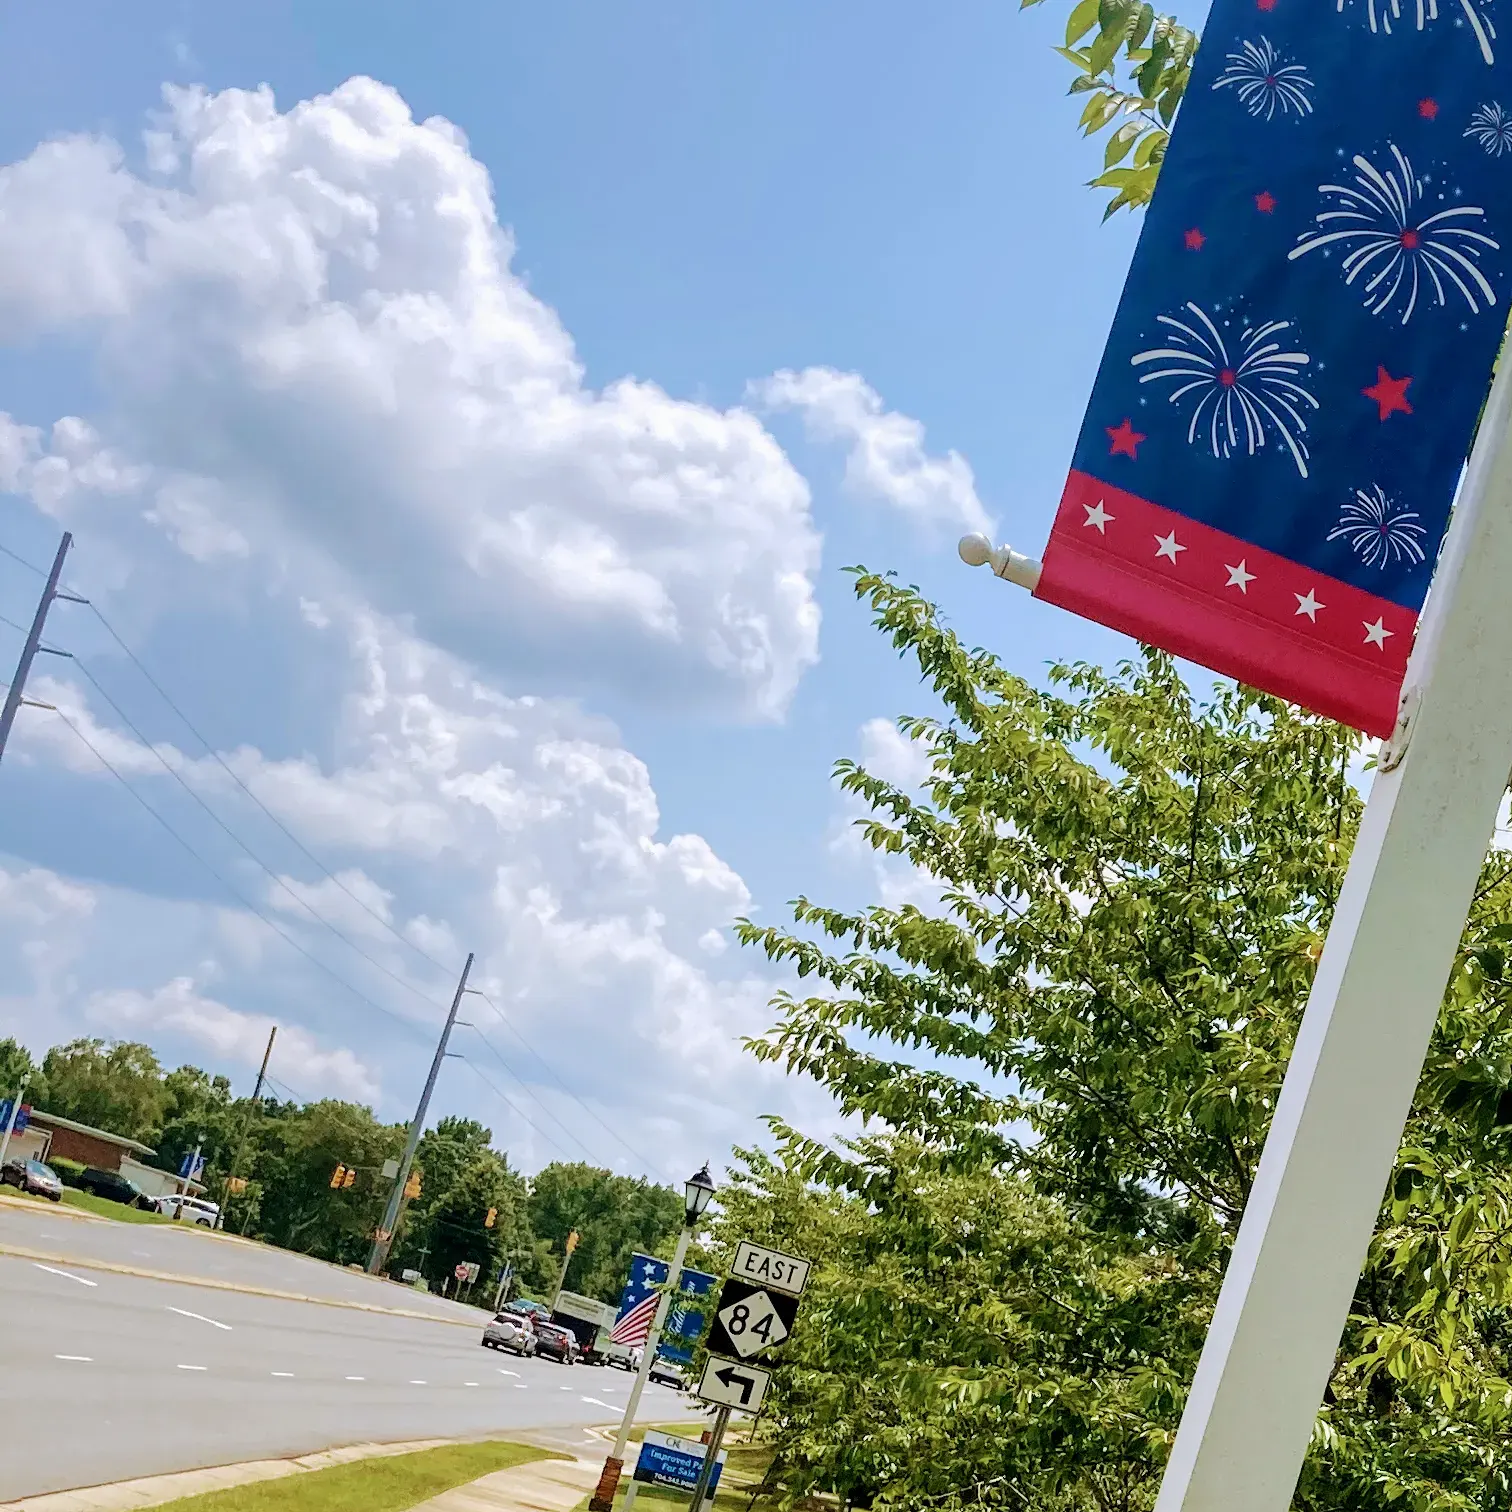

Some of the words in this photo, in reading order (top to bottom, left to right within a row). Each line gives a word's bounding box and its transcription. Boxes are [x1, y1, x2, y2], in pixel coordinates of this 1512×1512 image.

[744, 1251, 799, 1284] EAST
[728, 1304, 774, 1344] 84
[650, 1449, 692, 1468] Improved
[661, 1462, 677, 1473] For
[677, 1467, 696, 1479] Sale
